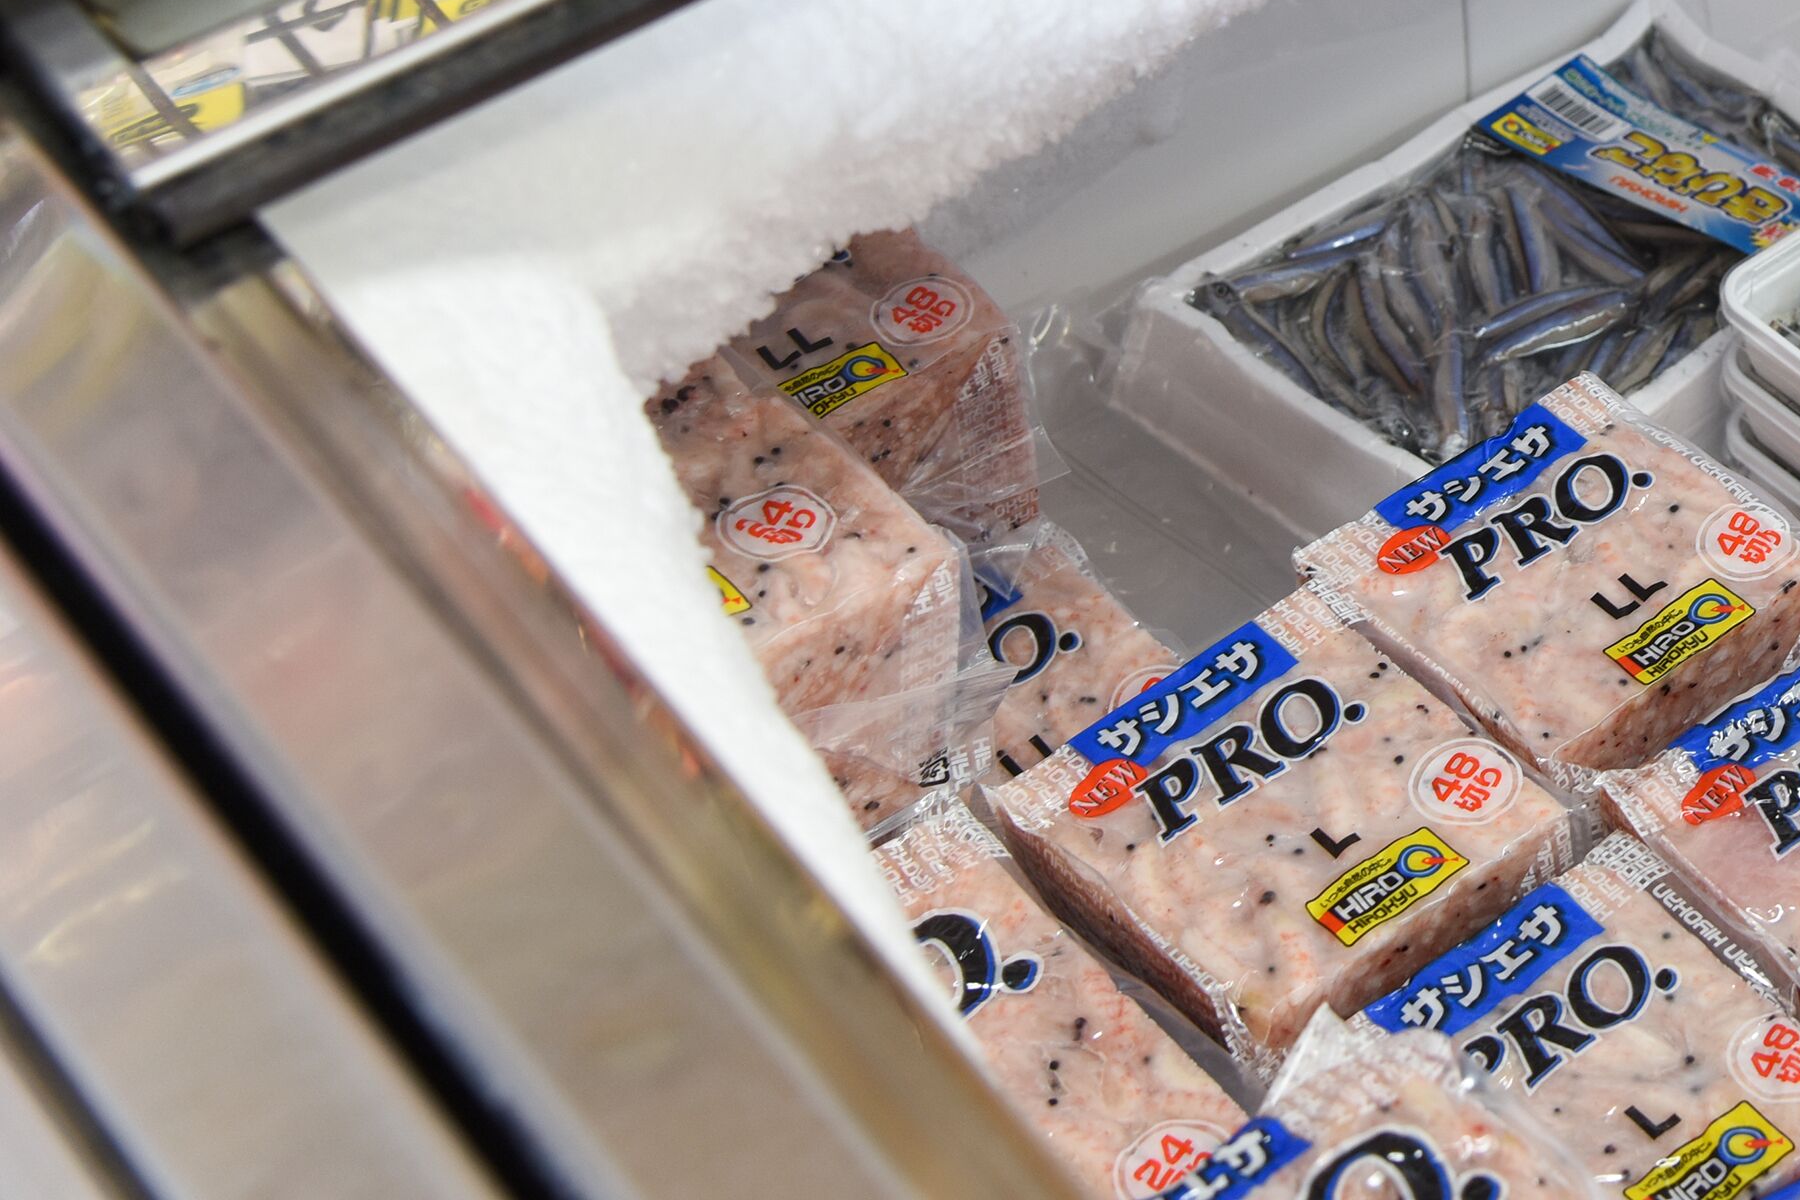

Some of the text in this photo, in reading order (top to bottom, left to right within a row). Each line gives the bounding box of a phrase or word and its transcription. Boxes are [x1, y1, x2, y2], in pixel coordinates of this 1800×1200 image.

[1587, 129, 1792, 225] きびなご
[891, 286, 940, 326] 48
[755, 328, 834, 371] LL
[1405, 423, 1555, 523] サシエサ
[1379, 526, 1447, 573] NEW
[1714, 510, 1761, 564] 48
[1738, 527, 1782, 565] 切り
[1590, 573, 1669, 620] LL
[1646, 630, 1709, 678] HIROKYU
[1097, 641, 1258, 757] サシエサ
[1072, 760, 1139, 815] NEW
[1430, 751, 1483, 802] 48
[1454, 762, 1505, 815] 切り
[1683, 764, 1754, 824] NEW
[1310, 827, 1361, 859] L
[1348, 883, 1419, 934] HIROKYU
[1399, 902, 1568, 1031] サシエサ
[1750, 1023, 1800, 1079] 48
[1624, 1105, 1682, 1141] L
